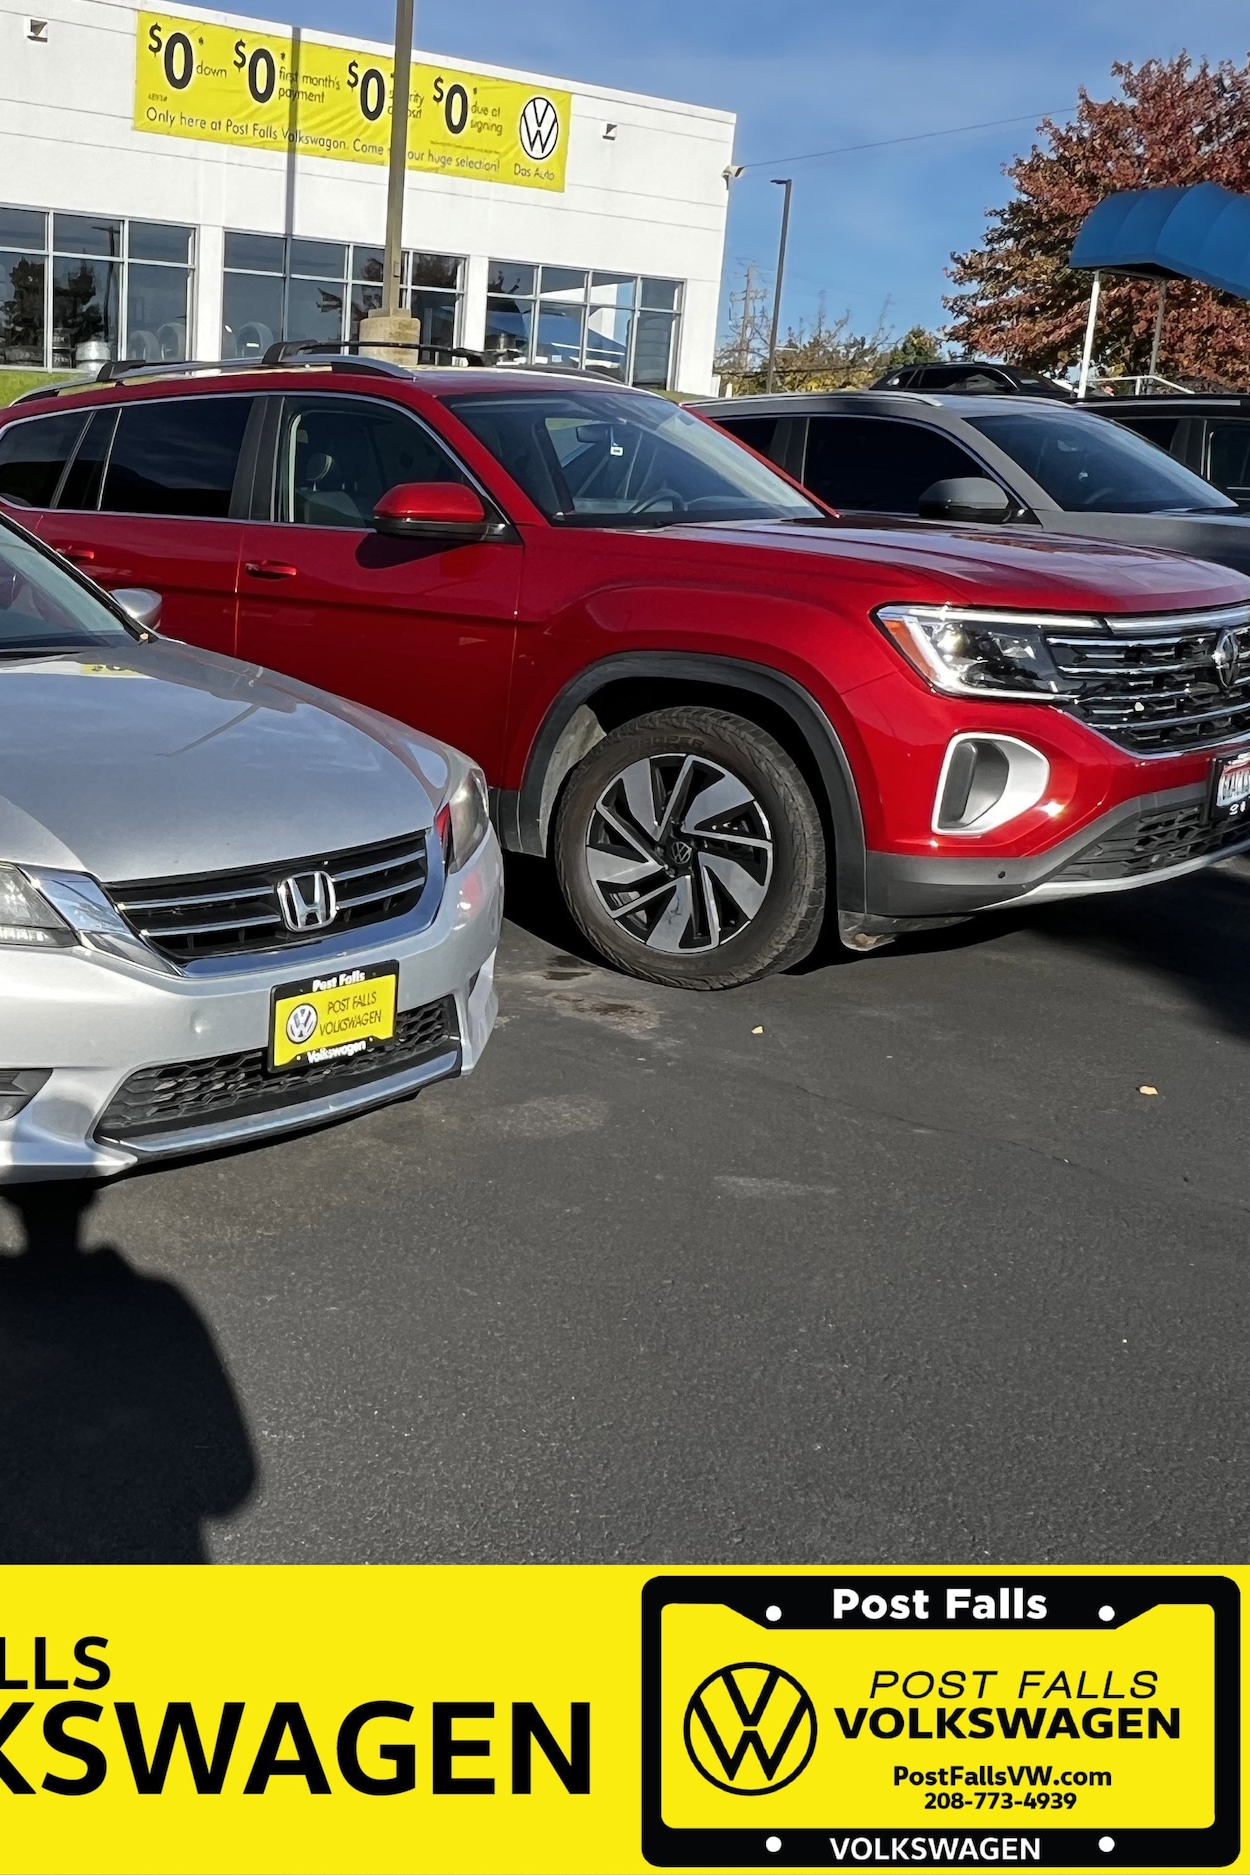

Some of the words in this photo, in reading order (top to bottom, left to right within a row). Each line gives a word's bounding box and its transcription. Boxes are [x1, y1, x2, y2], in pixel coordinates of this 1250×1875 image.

[196, 61, 227, 79] down
[279, 66, 299, 82] first
[302, 74, 340, 90] month's
[278, 87, 324, 104] payment
[471, 101, 488, 116] due
[146, 106, 175, 127] Only
[180, 112, 206, 129] here
[226, 118, 249, 135] Post
[253, 123, 278, 140] Falls
[353, 138, 384, 156] Come
[407, 150, 425, 160] our
[427, 149, 453, 168] huge
[455, 157, 500, 173] selection!
[513, 162, 531, 178] Das
[312, 977, 338, 993] Post
[339, 970, 365, 987] Falls
[327, 998, 350, 1015] POST
[352, 991, 377, 1010] FALLS
[319, 1009, 382, 1037] VOLKSWAGEN
[307, 1040, 367, 1064] Volkswagen
